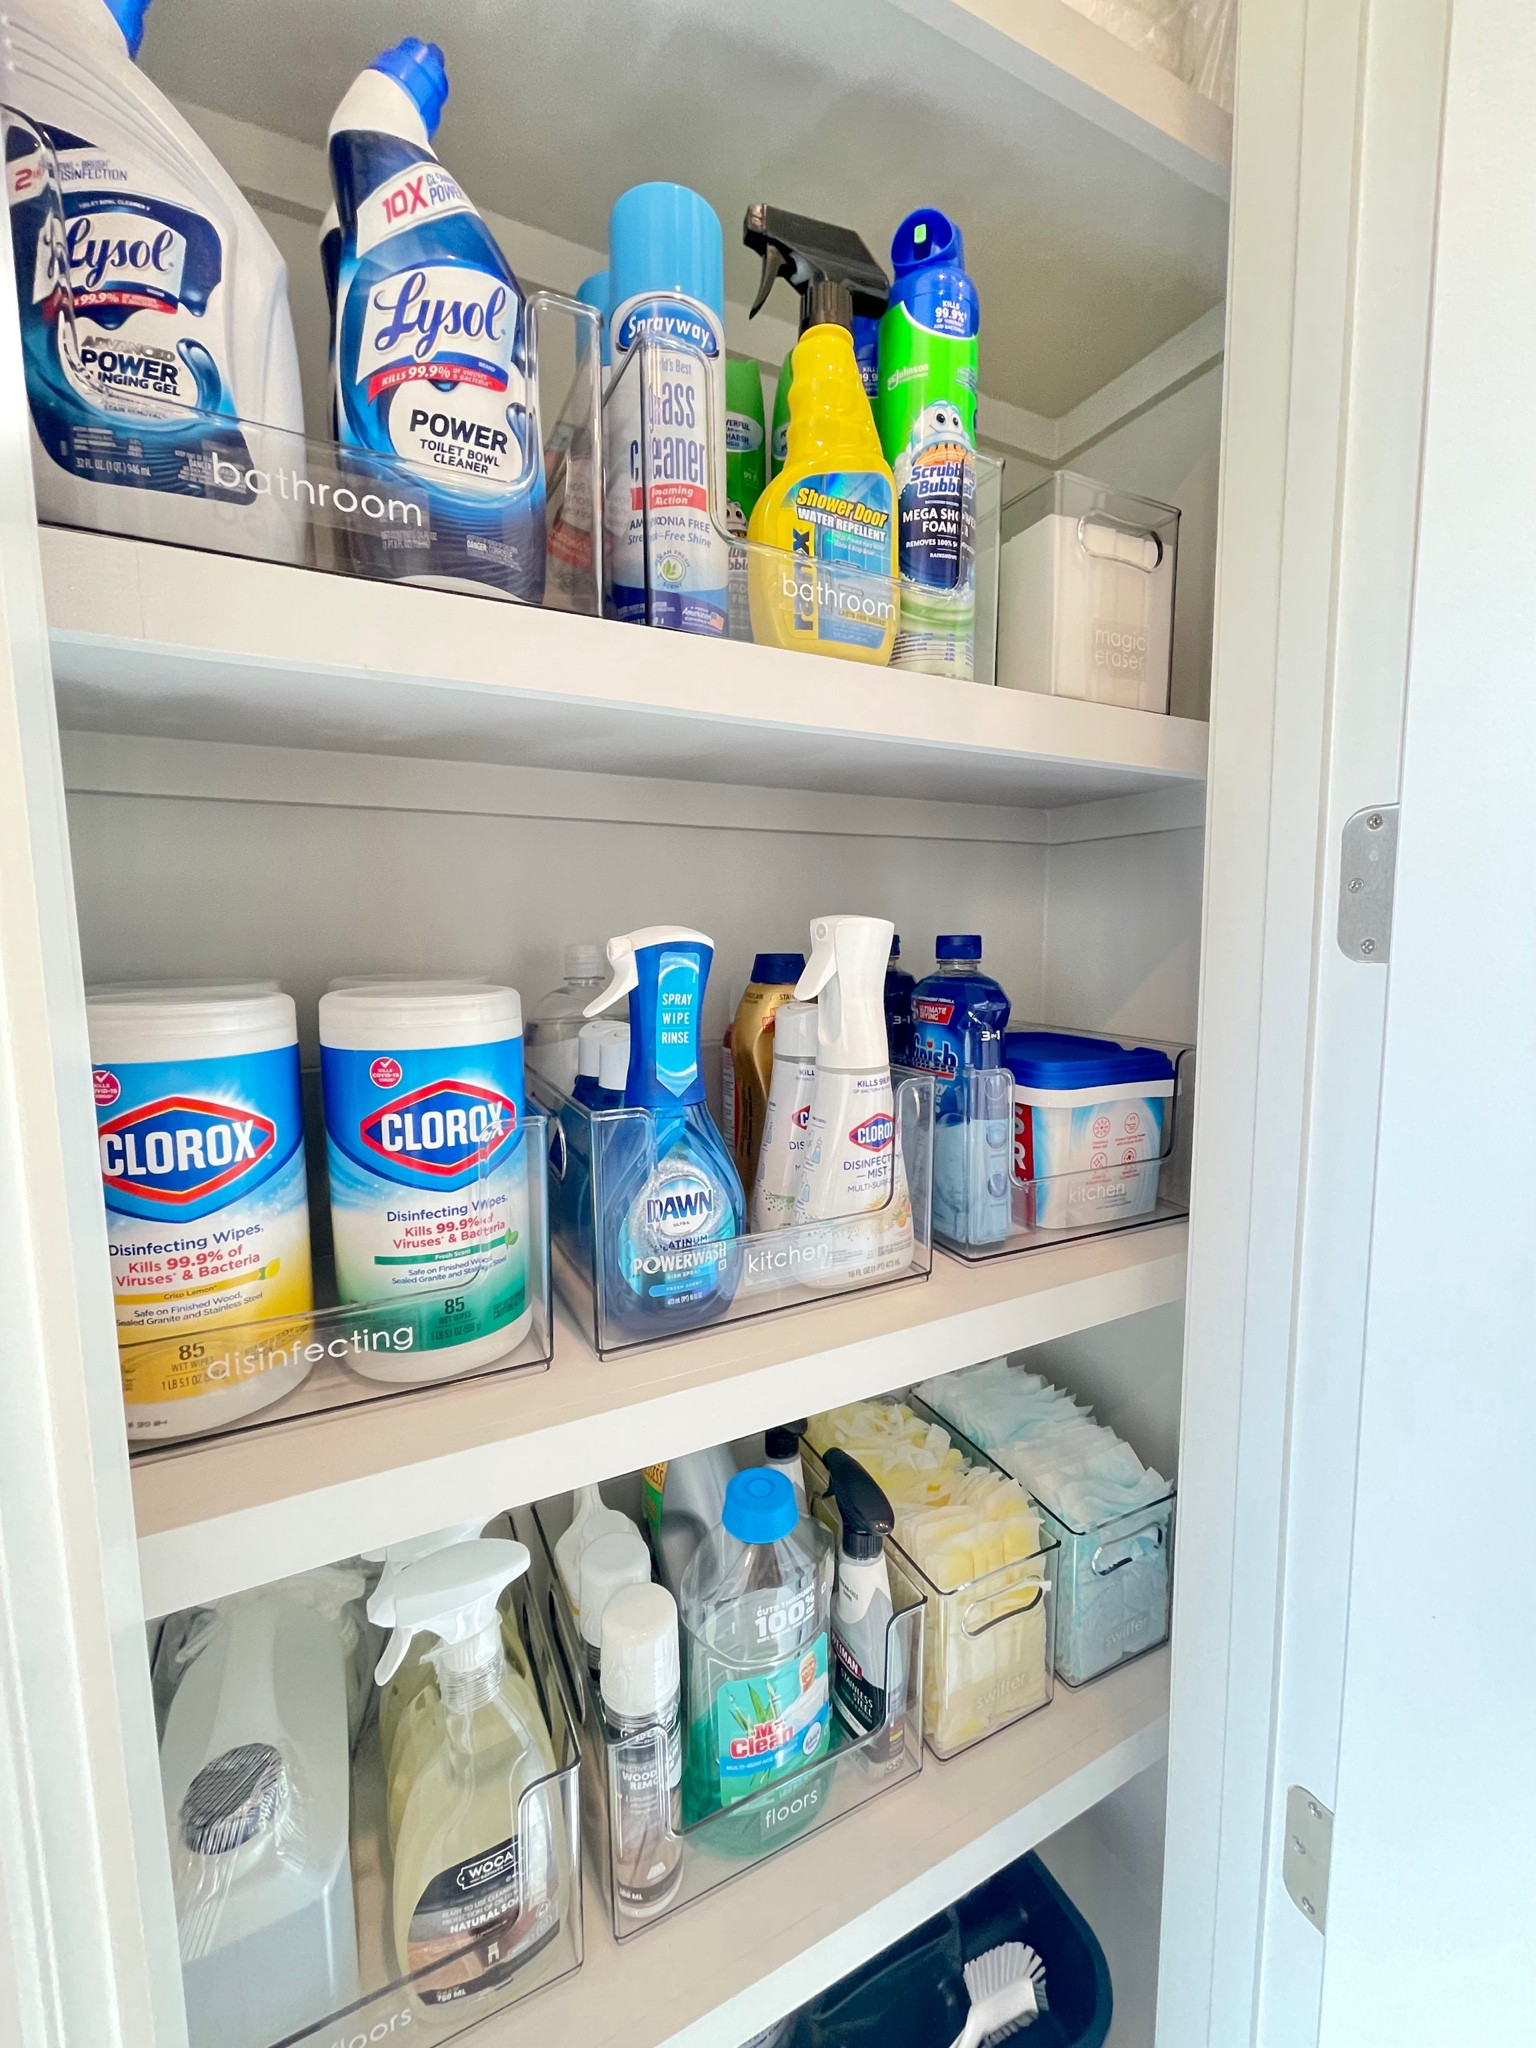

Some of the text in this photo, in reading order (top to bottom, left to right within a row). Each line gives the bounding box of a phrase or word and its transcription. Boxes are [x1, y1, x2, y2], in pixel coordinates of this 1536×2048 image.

[15, 168, 32, 191] 2
[382, 175, 428, 224] 10X
[62, 217, 173, 288] Lysol
[374, 272, 505, 360] Lysol
[942, 300, 960, 310] KILLS
[628, 315, 710, 348] Sprayway
[81, 348, 178, 386] POWER
[381, 371, 407, 387] KILLS
[408, 364, 451, 380] 99.9%
[675, 359, 692, 375] Best
[152, 382, 181, 397] GEL
[409, 408, 508, 455] POWER
[726, 420, 751, 431] ERFUL
[420, 438, 500, 467] TOILET BOWL
[433, 453, 489, 475] CLEANER
[630, 436, 705, 486] ceaner
[211, 452, 422, 527] bathroom
[796, 487, 889, 528] Shower Door
[902, 507, 938, 524] MEGA
[629, 516, 710, 534] AMONIA FREE
[797, 507, 886, 542] WATER REPELLENT
[688, 531, 712, 549] Shine
[906, 539, 936, 549] REMOVES
[930, 552, 958, 561] RAINSHOW
[783, 572, 896, 621] bathroom
[1095, 629, 1146, 653] magic
[1095, 649, 1145, 670] eraser
[662, 993, 692, 1006] SPRAY
[662, 1012, 690, 1025] WIPE
[661, 1031, 690, 1044] RINSE
[857, 1080, 878, 1088] KILLS
[381, 1101, 504, 1152] CLOROX
[100, 1119, 256, 1177] CLOROX
[843, 1153, 893, 1171] DISINFECT
[867, 1166, 888, 1180] MIST
[847, 1178, 892, 1193] MULTI-SURF
[1069, 1182, 1125, 1204] kitchen
[386, 1205, 468, 1222] Disinfecting
[646, 1189, 714, 1224] DAWN
[405, 1216, 479, 1238] Kills 99.9%
[673, 1220, 690, 1228] ULTRA
[109, 1235, 208, 1257] Disinfecting
[448, 1233, 457, 1243] &
[654, 1235, 709, 1254] ATINUM
[128, 1243, 244, 1275] Kills 99.9% of
[454, 1249, 471, 1257] Scent
[632, 1241, 726, 1276] POWERWASH
[748, 1243, 829, 1273] kitchen
[181, 1269, 194, 1281] &
[199, 1253, 261, 1279] Bacteria
[408, 1268, 425, 1276] Safe
[438, 1261, 470, 1272] Finished
[419, 1273, 447, 1283] Granite
[448, 1270, 462, 1278] and
[134, 1291, 243, 1318] Safe on Finished Wood,
[163, 1292, 185, 1300] Crisp
[444, 1296, 465, 1314] 85
[116, 1292, 264, 1327] Sealed Granite and Stainless Steel
[178, 1342, 205, 1361] 85
[207, 1326, 414, 1381] disinfecting
[171, 1362, 188, 1373] WET
[162, 1380, 166, 1390] 1
[168, 1377, 178, 1390] LB
[179, 1375, 190, 1388] 5.1
[1104, 1615, 1149, 1649] swiffer
[831, 1631, 859, 1675] WEIMAN
[840, 1667, 873, 1709] STAINLESS
[976, 1672, 1026, 1710] swiffer
[853, 1691, 873, 1718] STEEL
[730, 1726, 794, 1759] Clean
[765, 1790, 818, 1829] floors
[468, 1851, 513, 1879] WOCA
[450, 1896, 519, 1934] NATURAL SO
